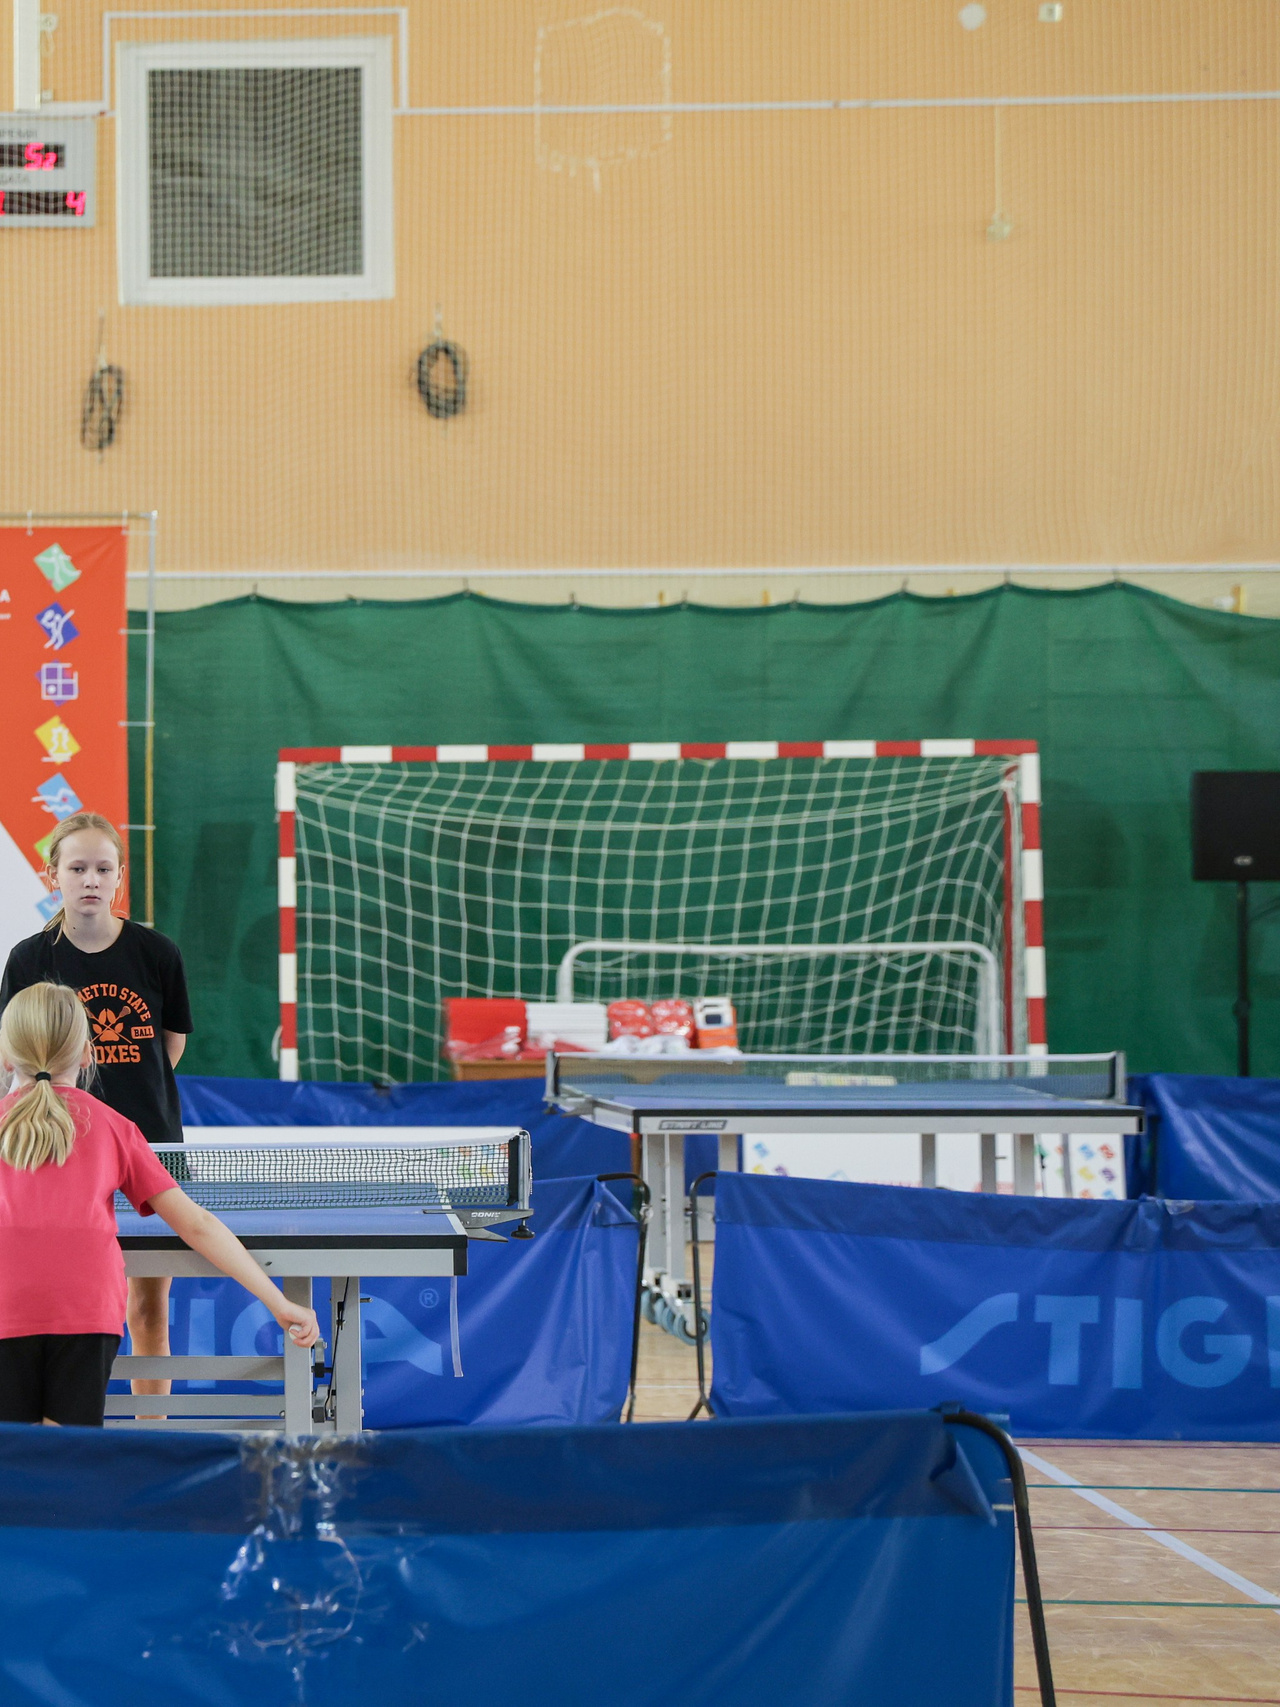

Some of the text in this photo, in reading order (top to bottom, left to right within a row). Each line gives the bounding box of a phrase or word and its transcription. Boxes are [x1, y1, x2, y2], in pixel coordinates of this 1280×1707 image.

[118, 987, 152, 1022] STATE
[133, 1028, 153, 1037] BALL
[95, 1044, 141, 1064] OXES
[921, 1292, 1280, 1389] STIG
